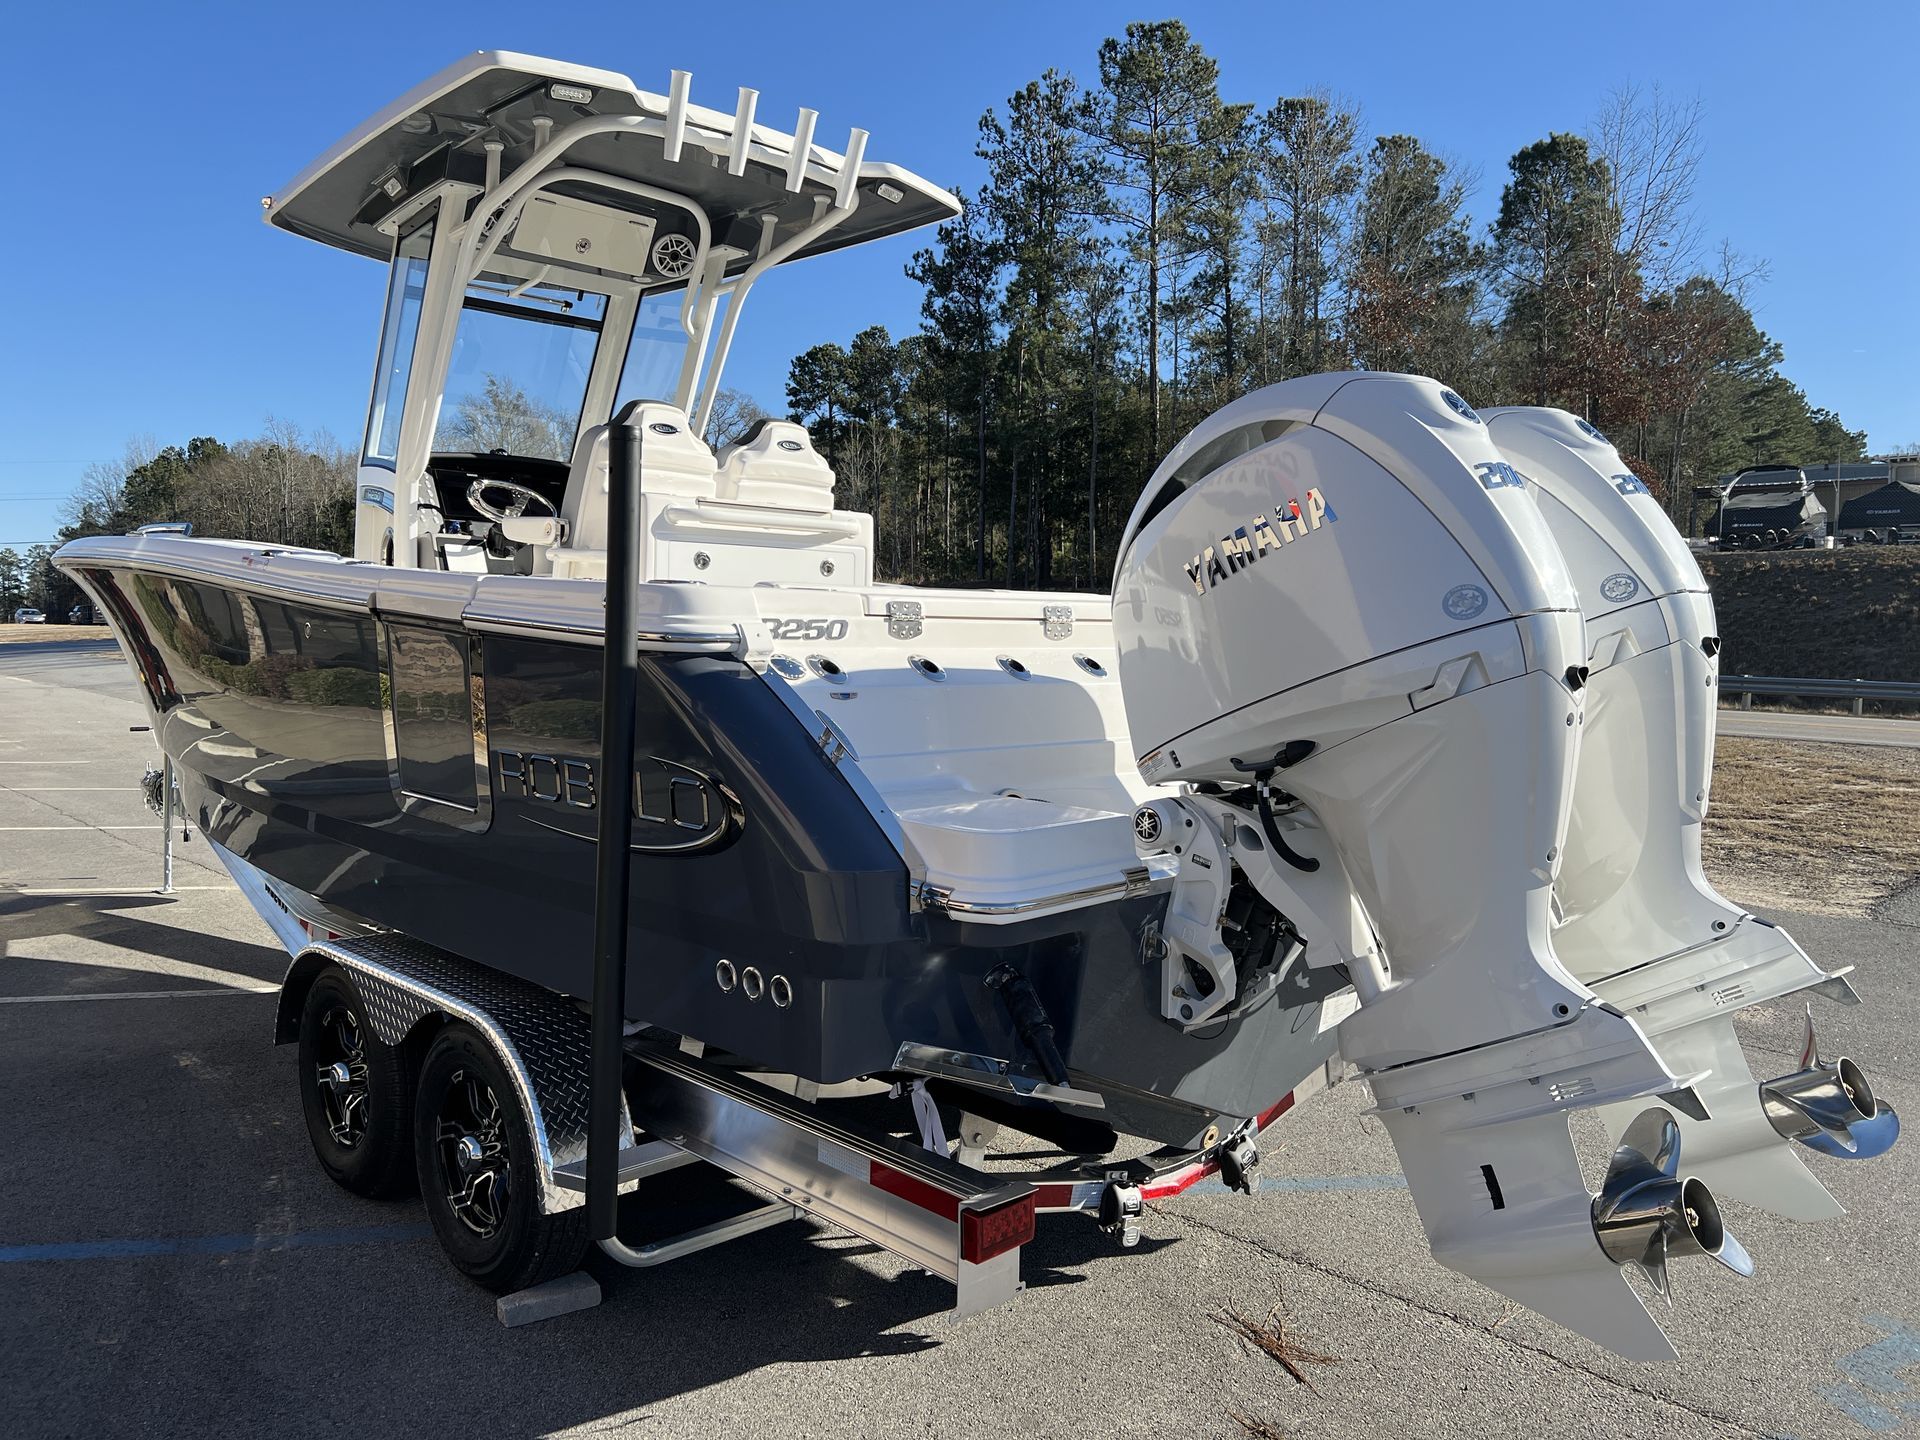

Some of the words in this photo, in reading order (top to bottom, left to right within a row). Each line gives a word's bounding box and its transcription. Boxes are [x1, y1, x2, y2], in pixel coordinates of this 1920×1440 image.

[1473, 461, 1525, 489] 20
[1183, 487, 1338, 596] YAMAHA
[499, 749, 709, 831] ROBLO
